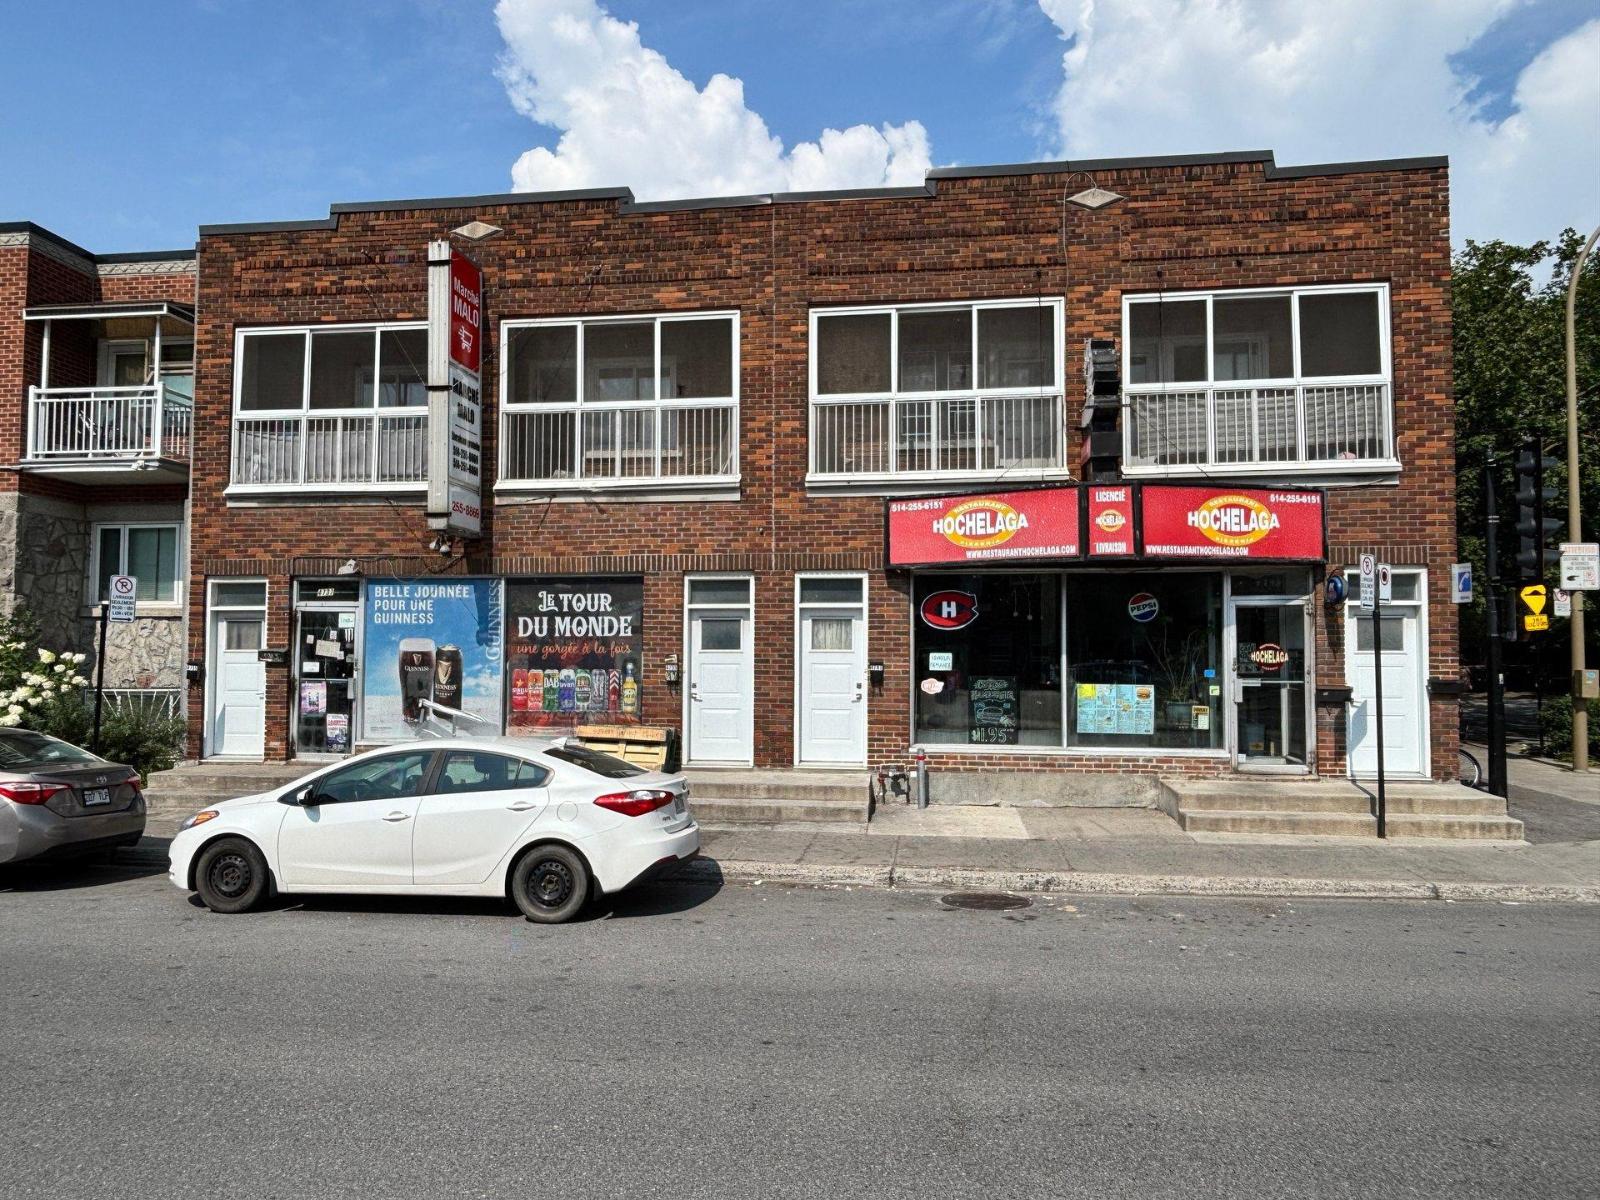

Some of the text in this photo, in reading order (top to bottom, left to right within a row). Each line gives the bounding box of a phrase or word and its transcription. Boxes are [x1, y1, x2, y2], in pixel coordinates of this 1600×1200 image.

[453, 276, 480, 307] Marché
[454, 294, 479, 328] MALO
[1095, 489, 1126, 502] LICENCIÉ
[1269, 493, 1320, 504] 514-255-6151
[891, 500, 944, 512] 514-255-6151
[932, 511, 1028, 536] HOCHELAGA
[1187, 508, 1280, 532] HOCHELAGA
[965, 545, 1077, 559] WWW.RESTAURANTHOCHELAGA.COM
[1095, 541, 1127, 553] LIVRAISON
[1145, 544, 1249, 556] WWW.RESTAURANTHOCHELAGA.COM
[374, 583, 470, 599] BELLE JOURNÉE
[374, 599, 434, 611] POUR UNE
[559, 593, 612, 612] TOUR
[1130, 601, 1158, 615] PEPSI
[374, 612, 434, 625] GUINNESS
[485, 579, 502, 661] GUINNESS
[518, 615, 632, 637] DU MONDE
[517, 644, 538, 654] une
[542, 643, 578, 660] gorgée
[594, 640, 607, 654] la
[610, 641, 632, 658] fois
[1250, 649, 1289, 664] HOCHELAGA
[544, 677, 560, 688] DAB
